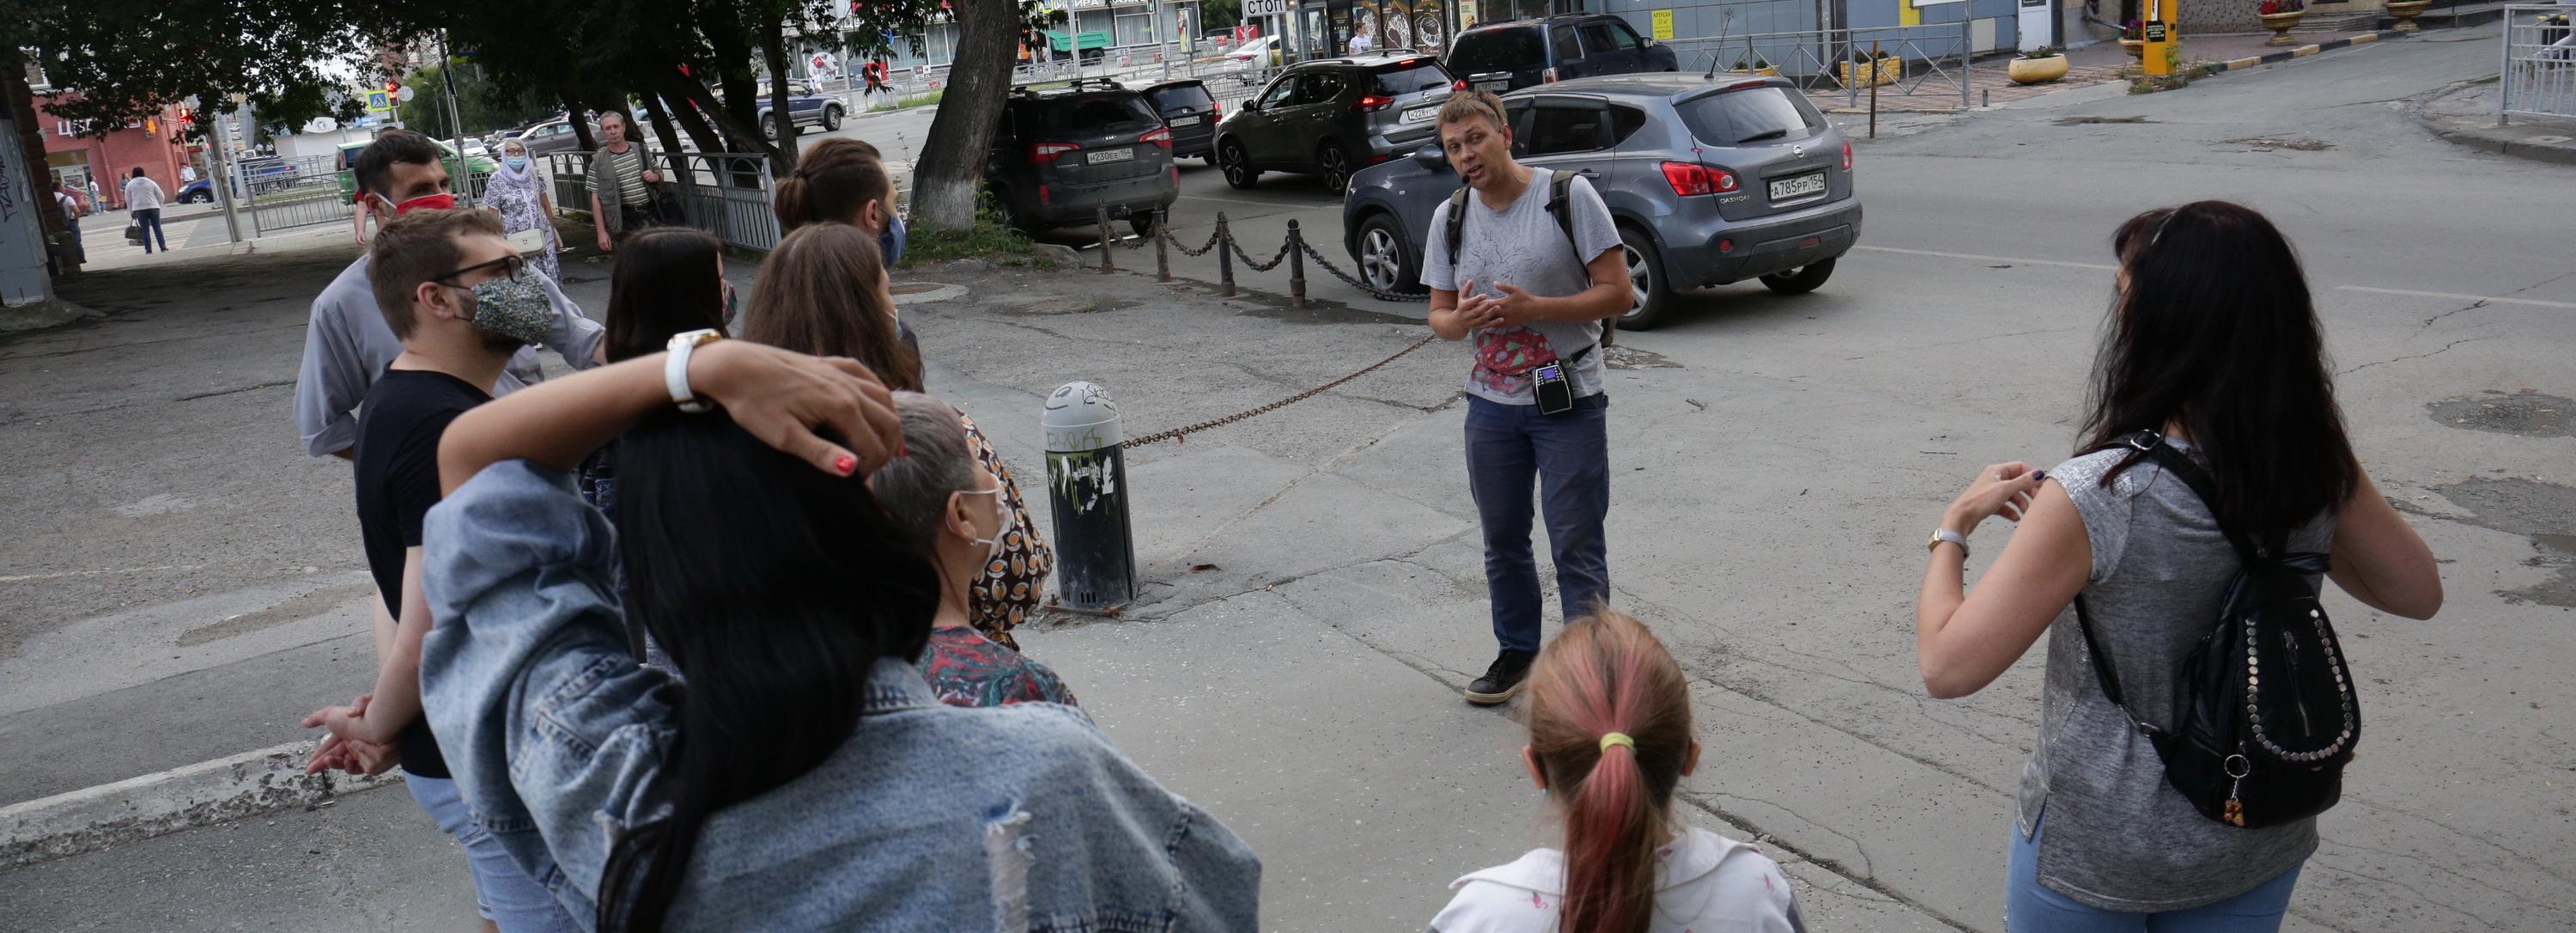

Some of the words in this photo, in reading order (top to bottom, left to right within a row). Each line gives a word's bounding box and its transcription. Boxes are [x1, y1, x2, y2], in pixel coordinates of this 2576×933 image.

[1249, 0, 1283, 14] СТОП
[1090, 150, 1120, 162] Н230ЕЕ
[1773, 179, 1807, 198] А785РР
[1809, 174, 1823, 186] 154
[1719, 194, 1750, 204] QASHQAI
